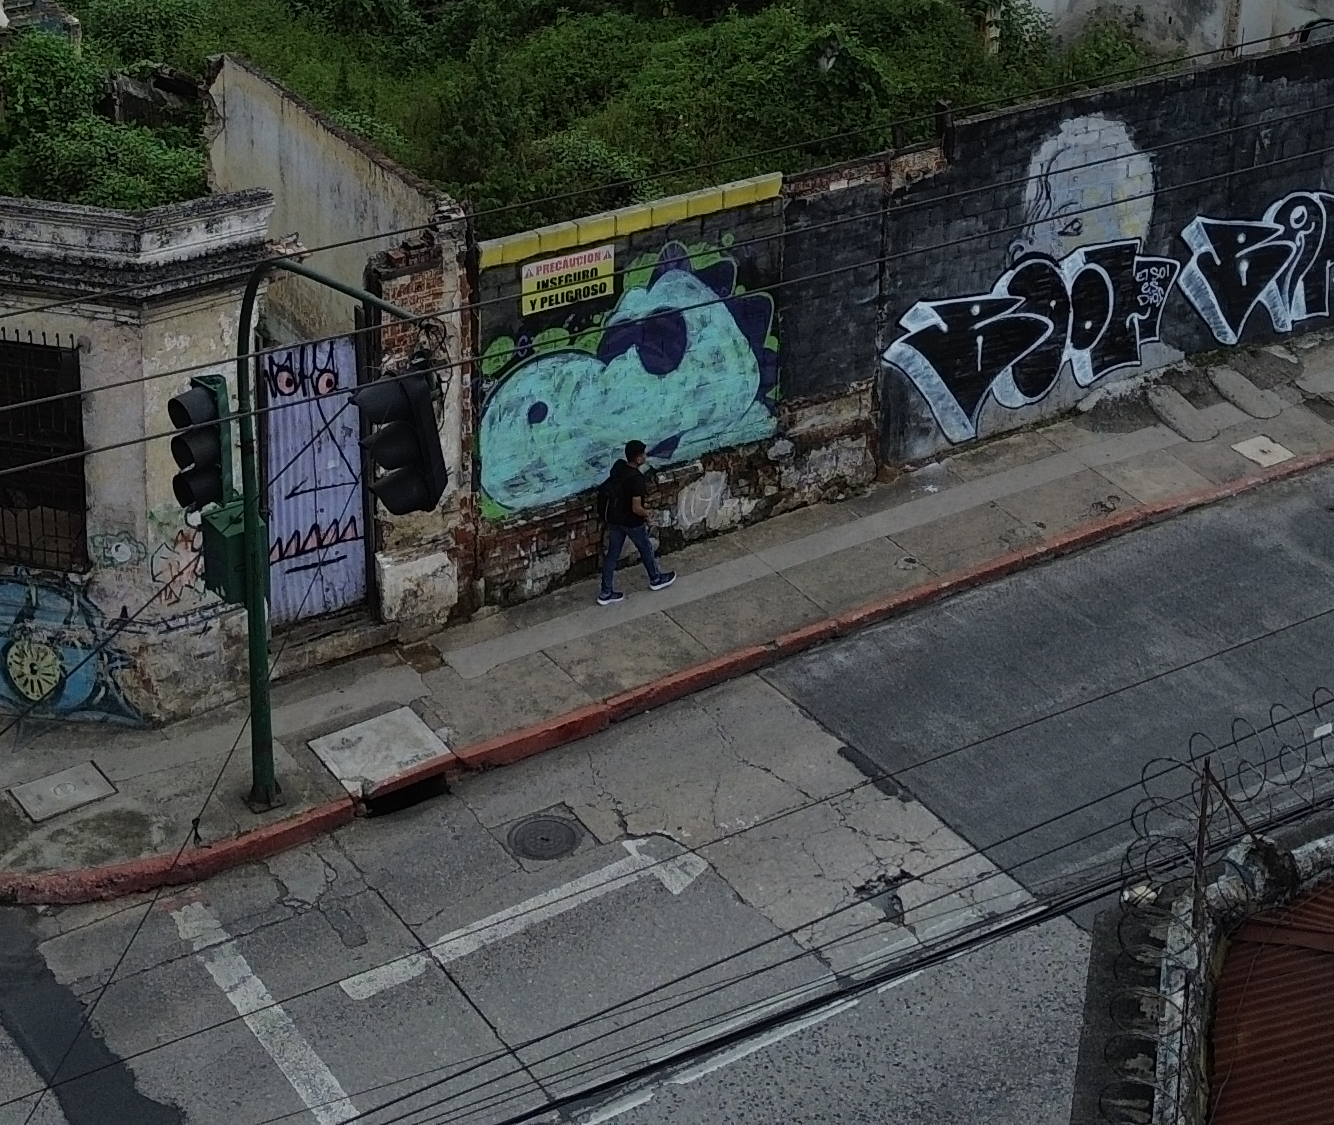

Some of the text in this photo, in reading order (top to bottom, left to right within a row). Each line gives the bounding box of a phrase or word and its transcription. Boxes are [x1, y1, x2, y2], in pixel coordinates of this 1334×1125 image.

[536, 267, 599, 290] INSEGURO
[529, 282, 607, 311] Y PELIGROSO
